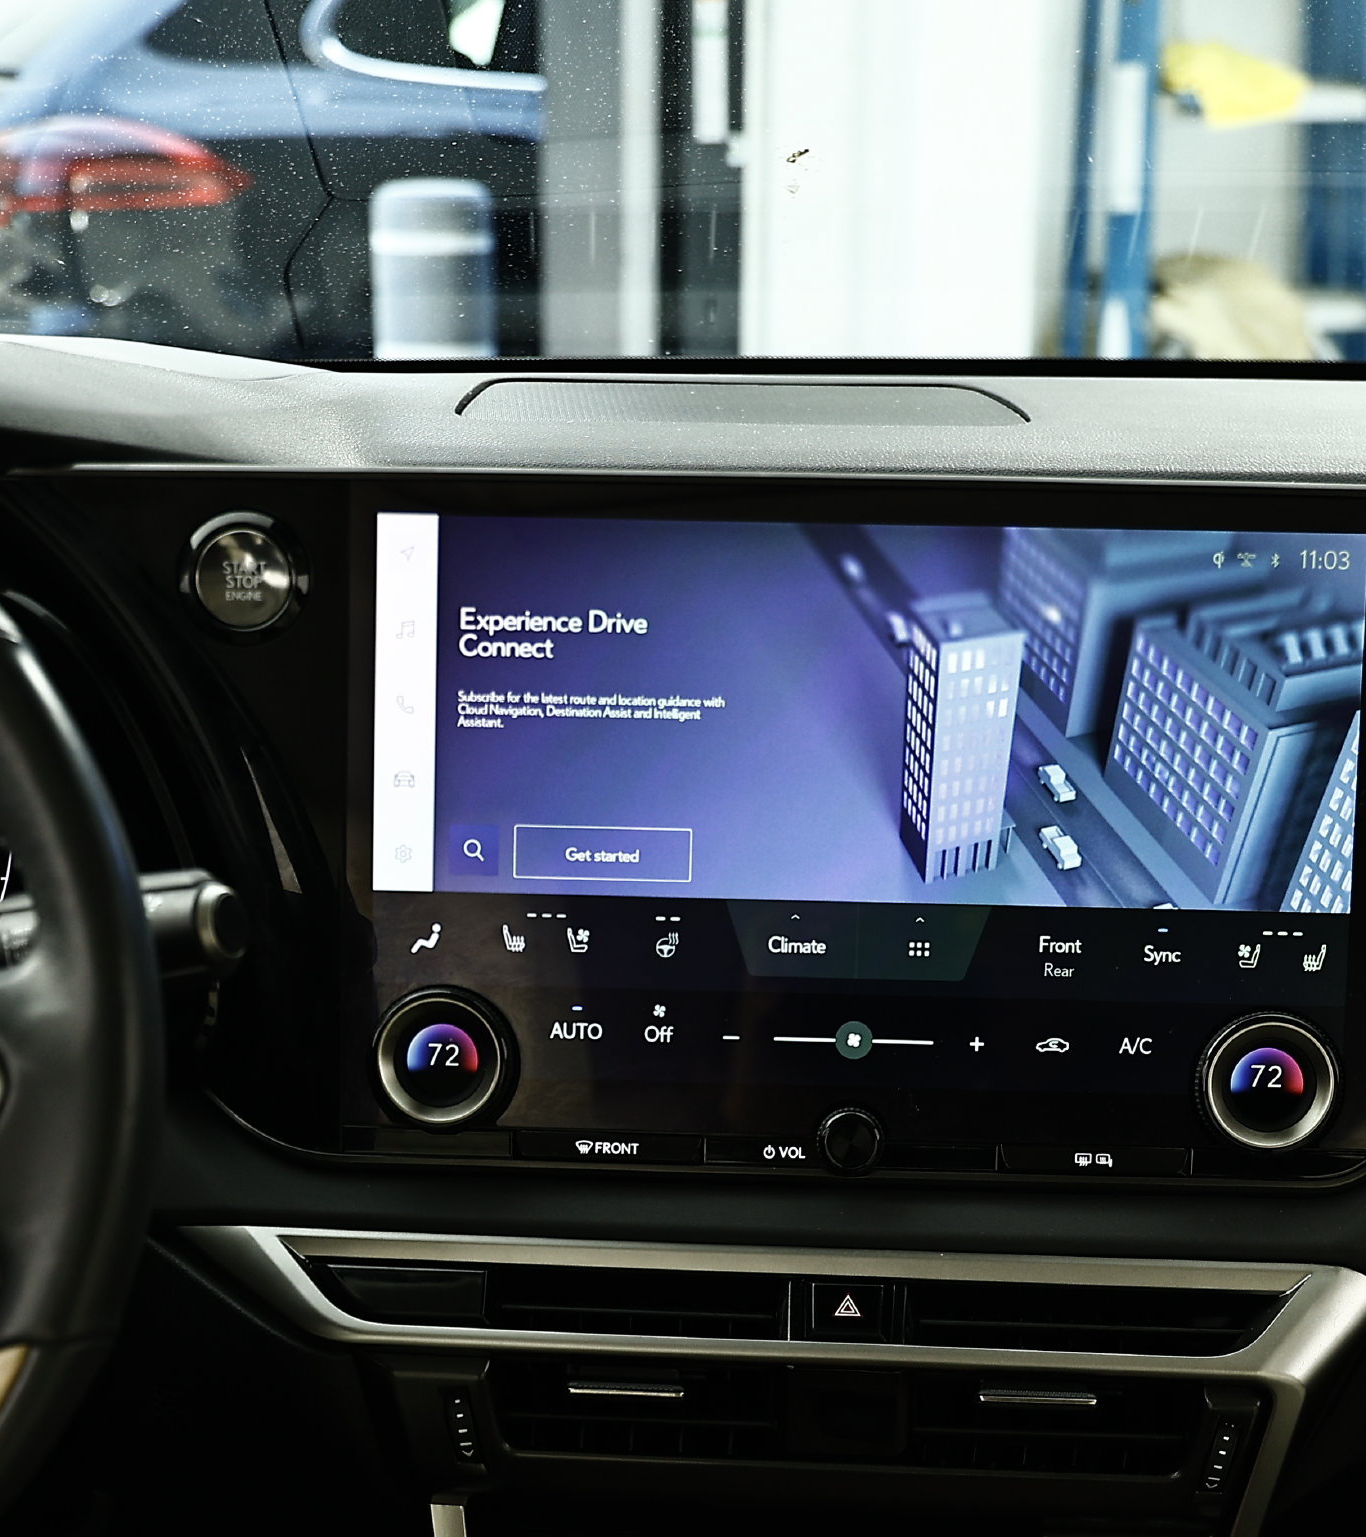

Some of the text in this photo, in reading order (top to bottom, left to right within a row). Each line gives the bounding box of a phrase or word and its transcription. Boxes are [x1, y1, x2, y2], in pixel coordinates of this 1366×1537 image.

[222, 561, 267, 575] START
[1299, 550, 1350, 571] 11:03
[225, 575, 264, 589] STOP
[225, 591, 263, 602] ENGINE
[459, 606, 648, 637] Experience Drive
[458, 633, 554, 659] Connect
[457, 690, 726, 710] Subscribe for the latest route and location guidance with
[456, 715, 505, 729] Assistant.
[457, 703, 701, 723] Cloud Navigation, Destination Assist and Intelligent
[564, 846, 640, 864] Get started
[767, 935, 827, 955] Climate
[1039, 936, 1082, 954] Front
[1143, 945, 1182, 966] Sync
[1044, 963, 1075, 978] Rear
[549, 1021, 604, 1041] AUTO
[644, 1025, 675, 1044] Off
[427, 1042, 461, 1068] 72
[1119, 1037, 1154, 1056] A/C
[1250, 1065, 1284, 1090] 72
[594, 1141, 640, 1157] FRONT
[778, 1146, 807, 1160] VOL
